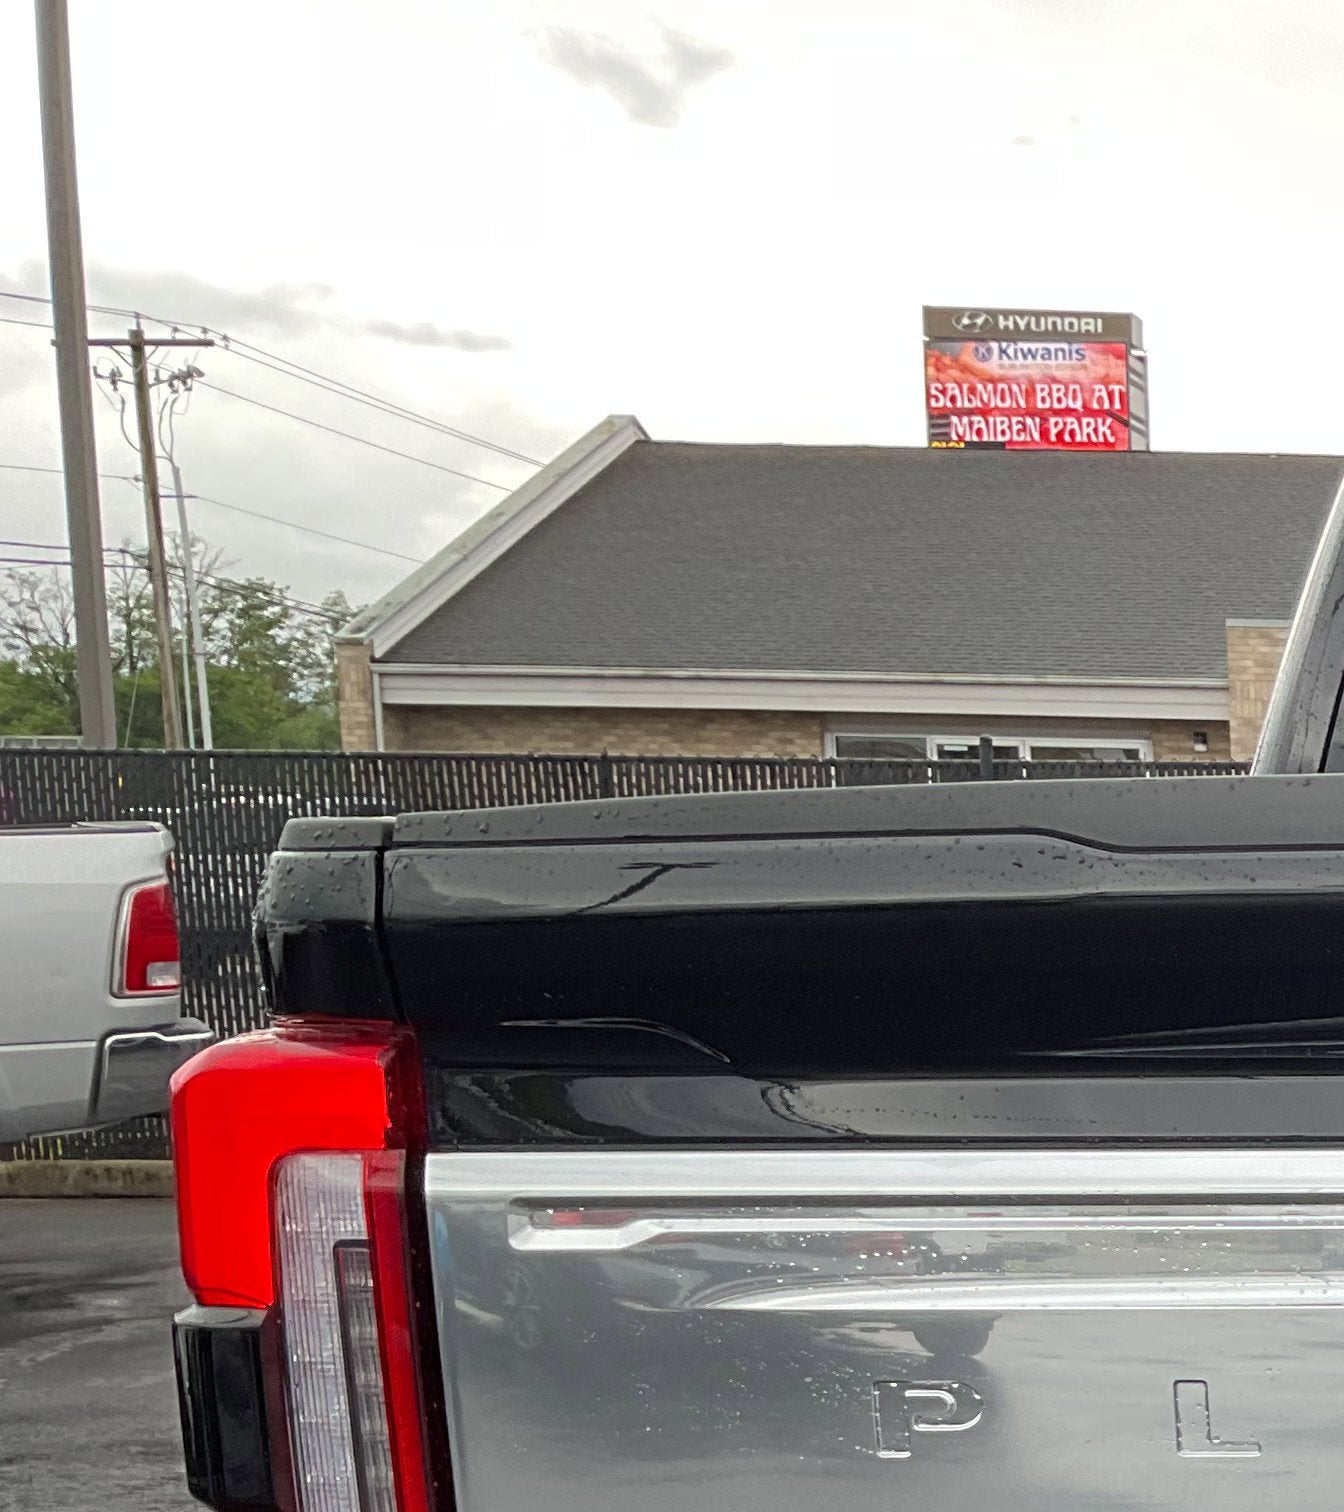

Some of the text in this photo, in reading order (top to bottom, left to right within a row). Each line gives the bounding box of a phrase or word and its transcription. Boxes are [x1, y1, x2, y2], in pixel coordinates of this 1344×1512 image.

[998, 314, 1103, 334] HYUNDAI
[998, 341, 1086, 362] Kiwanis
[929, 382, 1125, 412] SALMON BBQ AT
[950, 415, 1116, 444] MAIBEN PARK
